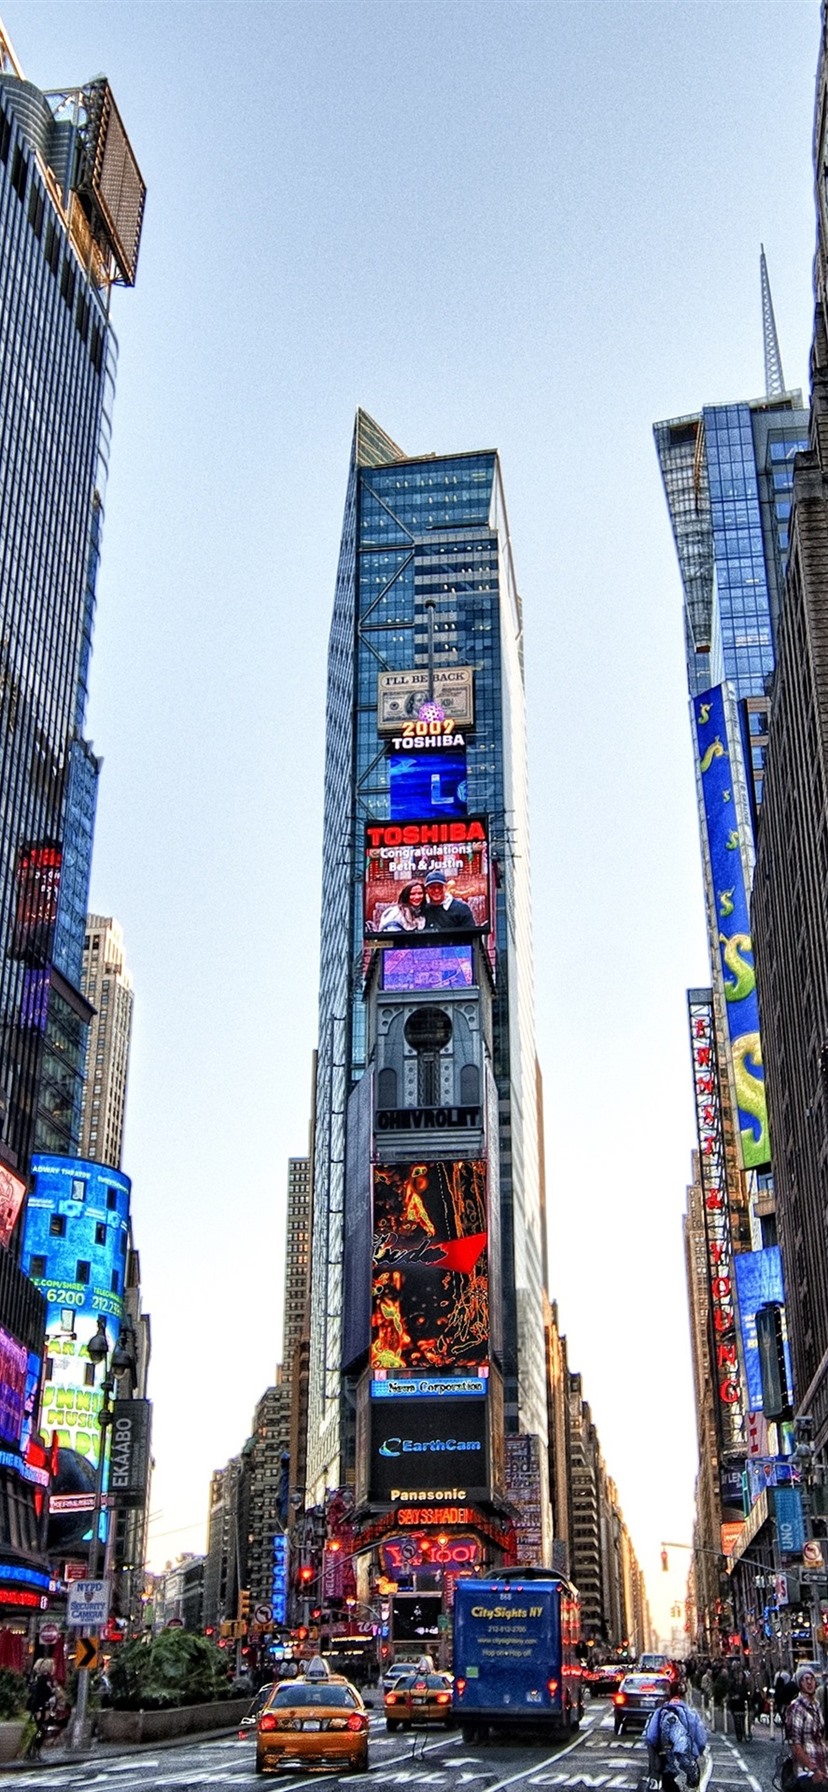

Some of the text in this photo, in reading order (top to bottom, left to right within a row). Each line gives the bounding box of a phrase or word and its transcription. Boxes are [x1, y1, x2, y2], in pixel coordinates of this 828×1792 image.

[386, 672, 464, 686] I'LL BE BACK
[402, 719, 455, 737] 2009
[392, 735, 465, 750] TOSHIBA
[367, 821, 486, 846] TOSHIBA
[380, 844, 472, 860] Congratulations
[389, 857, 463, 872] Beth & Justin
[377, 1108, 479, 1130] CHEVROLET
[46, 1288, 86, 1307] 6200
[710, 1241, 740, 1404] YOUNG
[420, 1380, 483, 1395] Corporation
[402, 1439, 481, 1452] EarthCam
[390, 1489, 467, 1501] Panasonic
[780, 1523, 794, 1550] UNO
[385, 1545, 476, 1567] YOO!
[77, 1583, 102, 1592] NYPD
[70, 1601, 106, 1610] SECURITY
[471, 1606, 543, 1620] CitySights NY
[71, 1610, 103, 1618] CAMERA
[338, 1771, 496, 1785] ONLY
[527, 1773, 645, 1789] ONL
